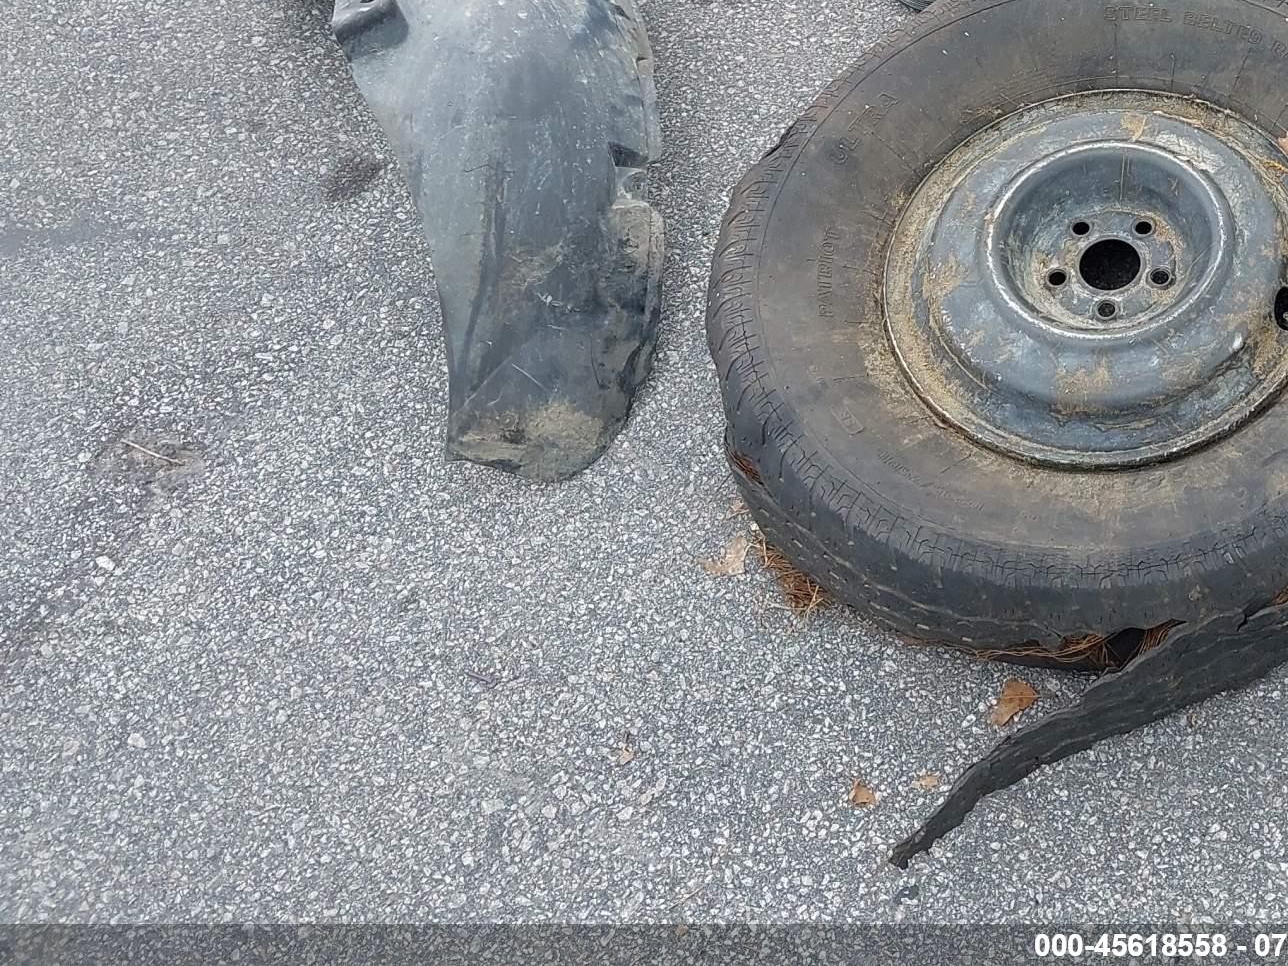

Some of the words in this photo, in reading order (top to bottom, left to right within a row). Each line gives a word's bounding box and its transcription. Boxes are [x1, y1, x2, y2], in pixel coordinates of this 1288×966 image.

[1103, 6, 1173, 23] STEEL
[1183, 10, 1263, 45] BELTED
[817, 226, 841, 317] PATRIOT
